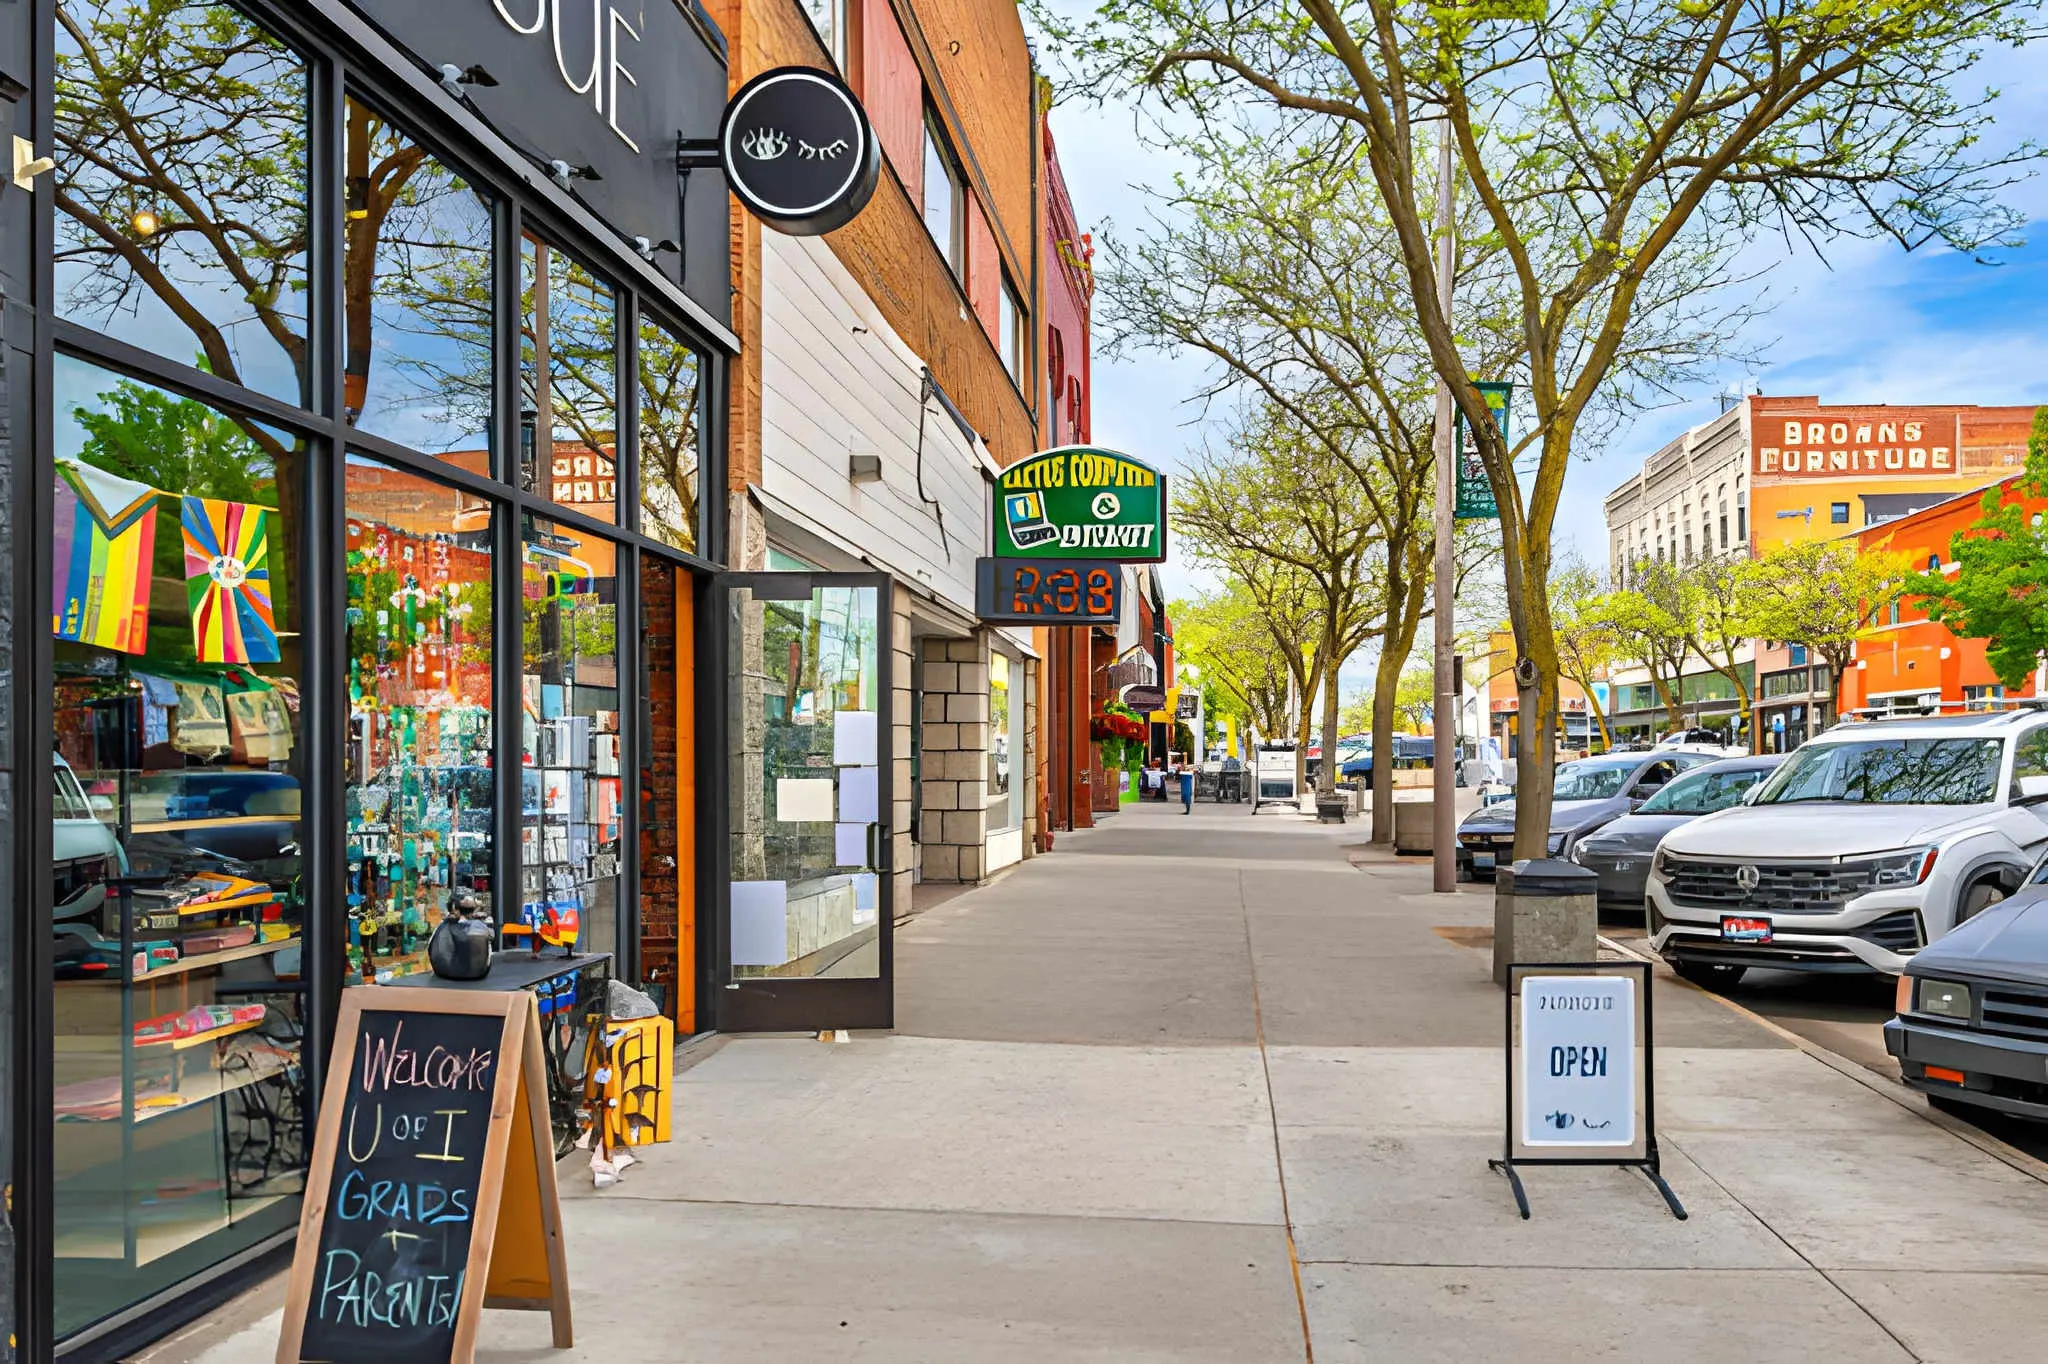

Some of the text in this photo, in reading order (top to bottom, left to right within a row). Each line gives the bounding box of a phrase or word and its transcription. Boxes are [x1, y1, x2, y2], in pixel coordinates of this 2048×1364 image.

[1550, 1046, 1607, 1077] OPEN
[348, 1102, 382, 1163] U
[415, 1109, 468, 1162] I
[338, 1168, 469, 1225] GRADS
